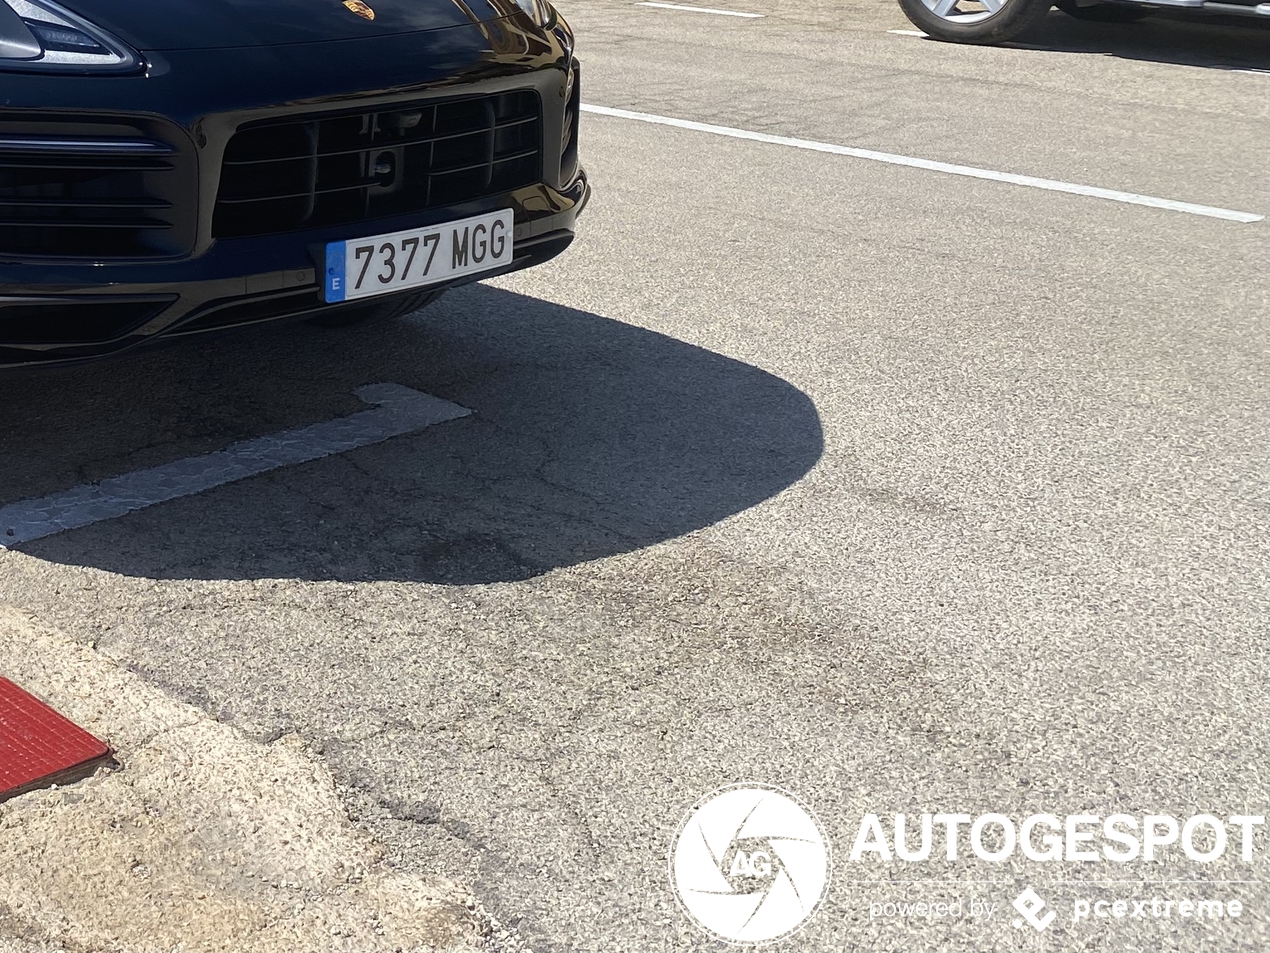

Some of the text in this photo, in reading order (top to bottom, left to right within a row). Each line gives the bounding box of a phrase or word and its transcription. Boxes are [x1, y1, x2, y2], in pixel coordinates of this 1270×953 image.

[354, 219, 505, 290] 7377 MGG
[331, 277, 341, 291] E
